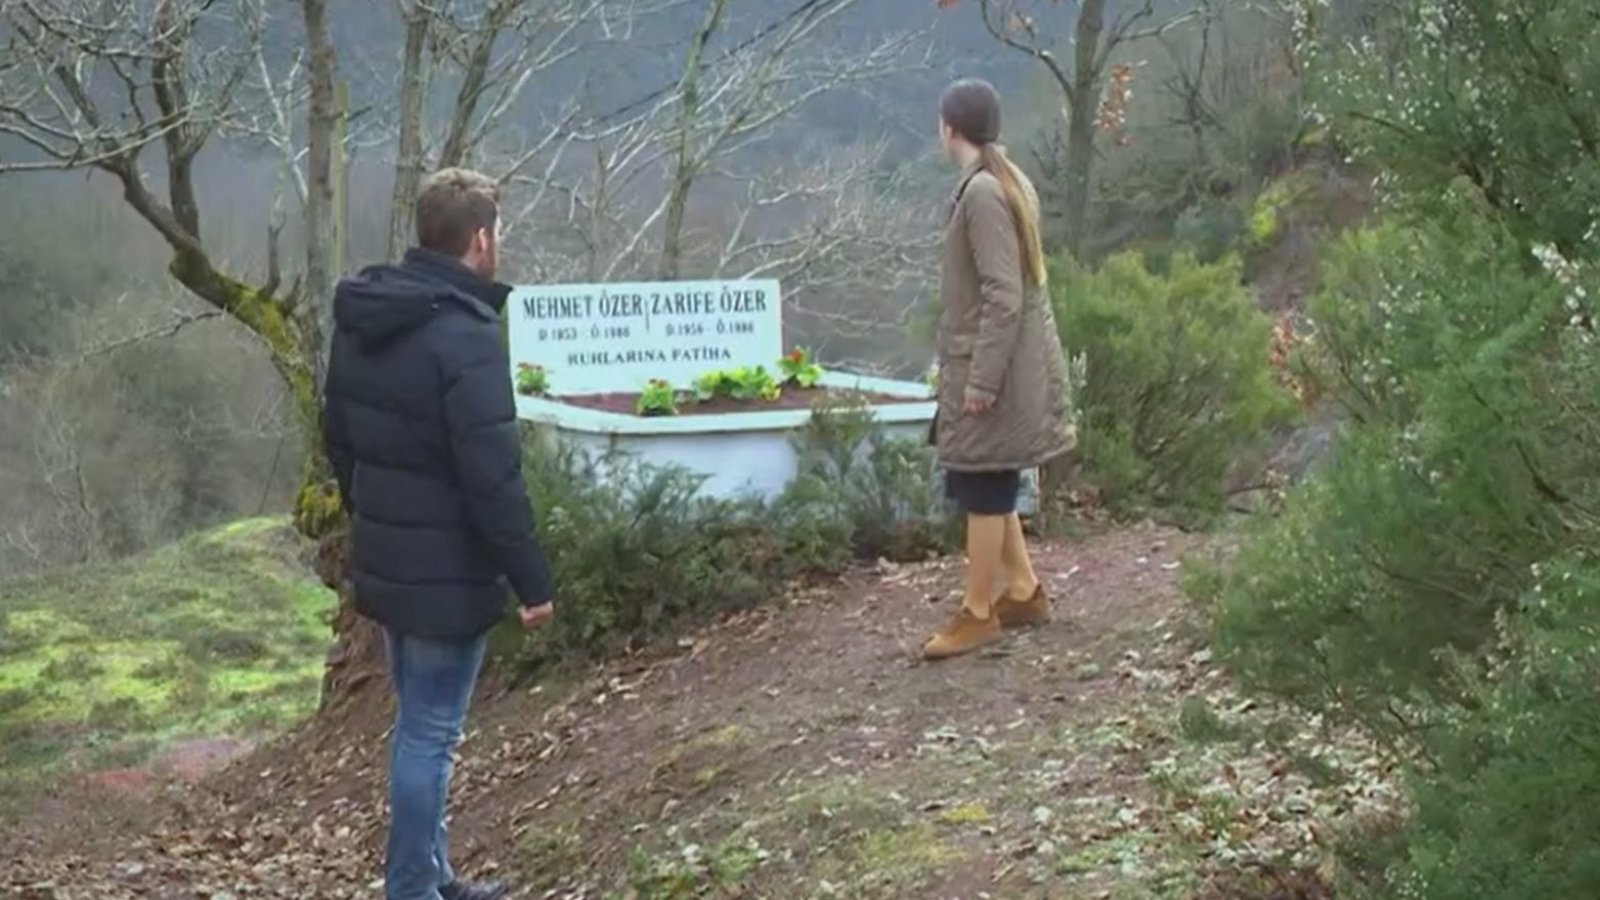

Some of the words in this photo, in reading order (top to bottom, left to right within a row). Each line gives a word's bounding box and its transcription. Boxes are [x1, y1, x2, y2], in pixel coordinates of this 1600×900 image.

[523, 295, 592, 319] MEHMET
[599, 288, 643, 318] ÖZER
[651, 290, 716, 315] ZARİFE
[720, 285, 766, 313] ÖZER
[568, 350, 666, 366] RUHLARINA
[671, 346, 732, 361] FATİHA
